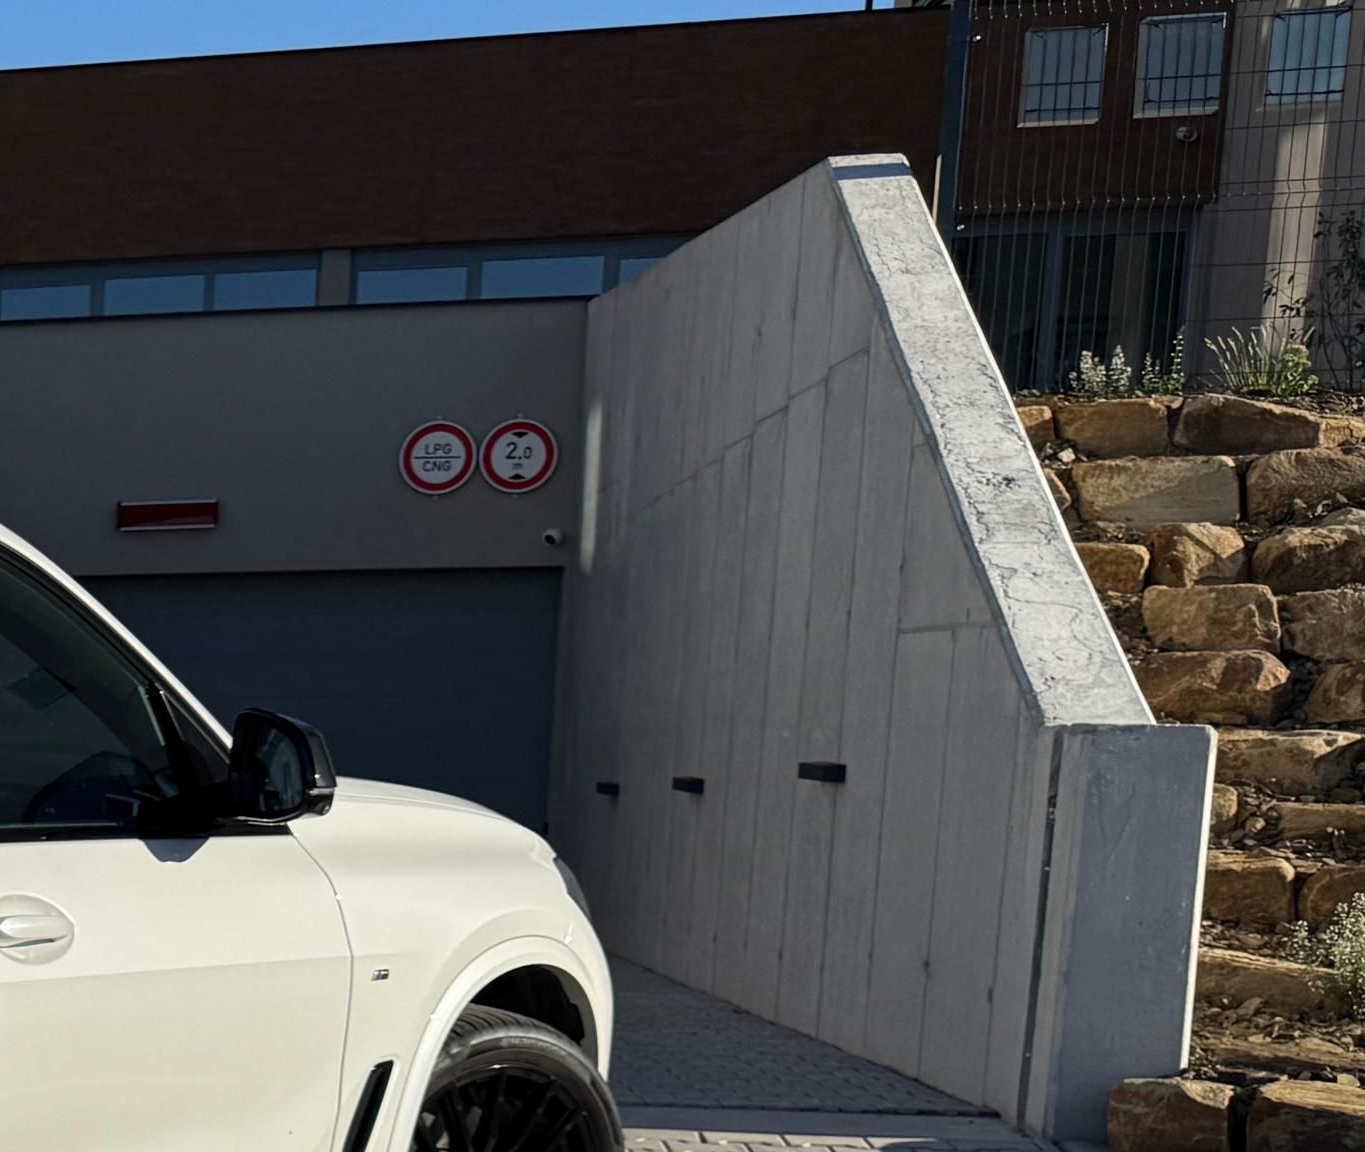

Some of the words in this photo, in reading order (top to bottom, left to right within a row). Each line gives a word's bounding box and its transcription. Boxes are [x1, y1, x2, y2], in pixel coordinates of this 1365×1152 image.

[424, 443, 453, 455] LPG
[506, 441, 533, 460] 2.0
[422, 460, 452, 472] CNG
